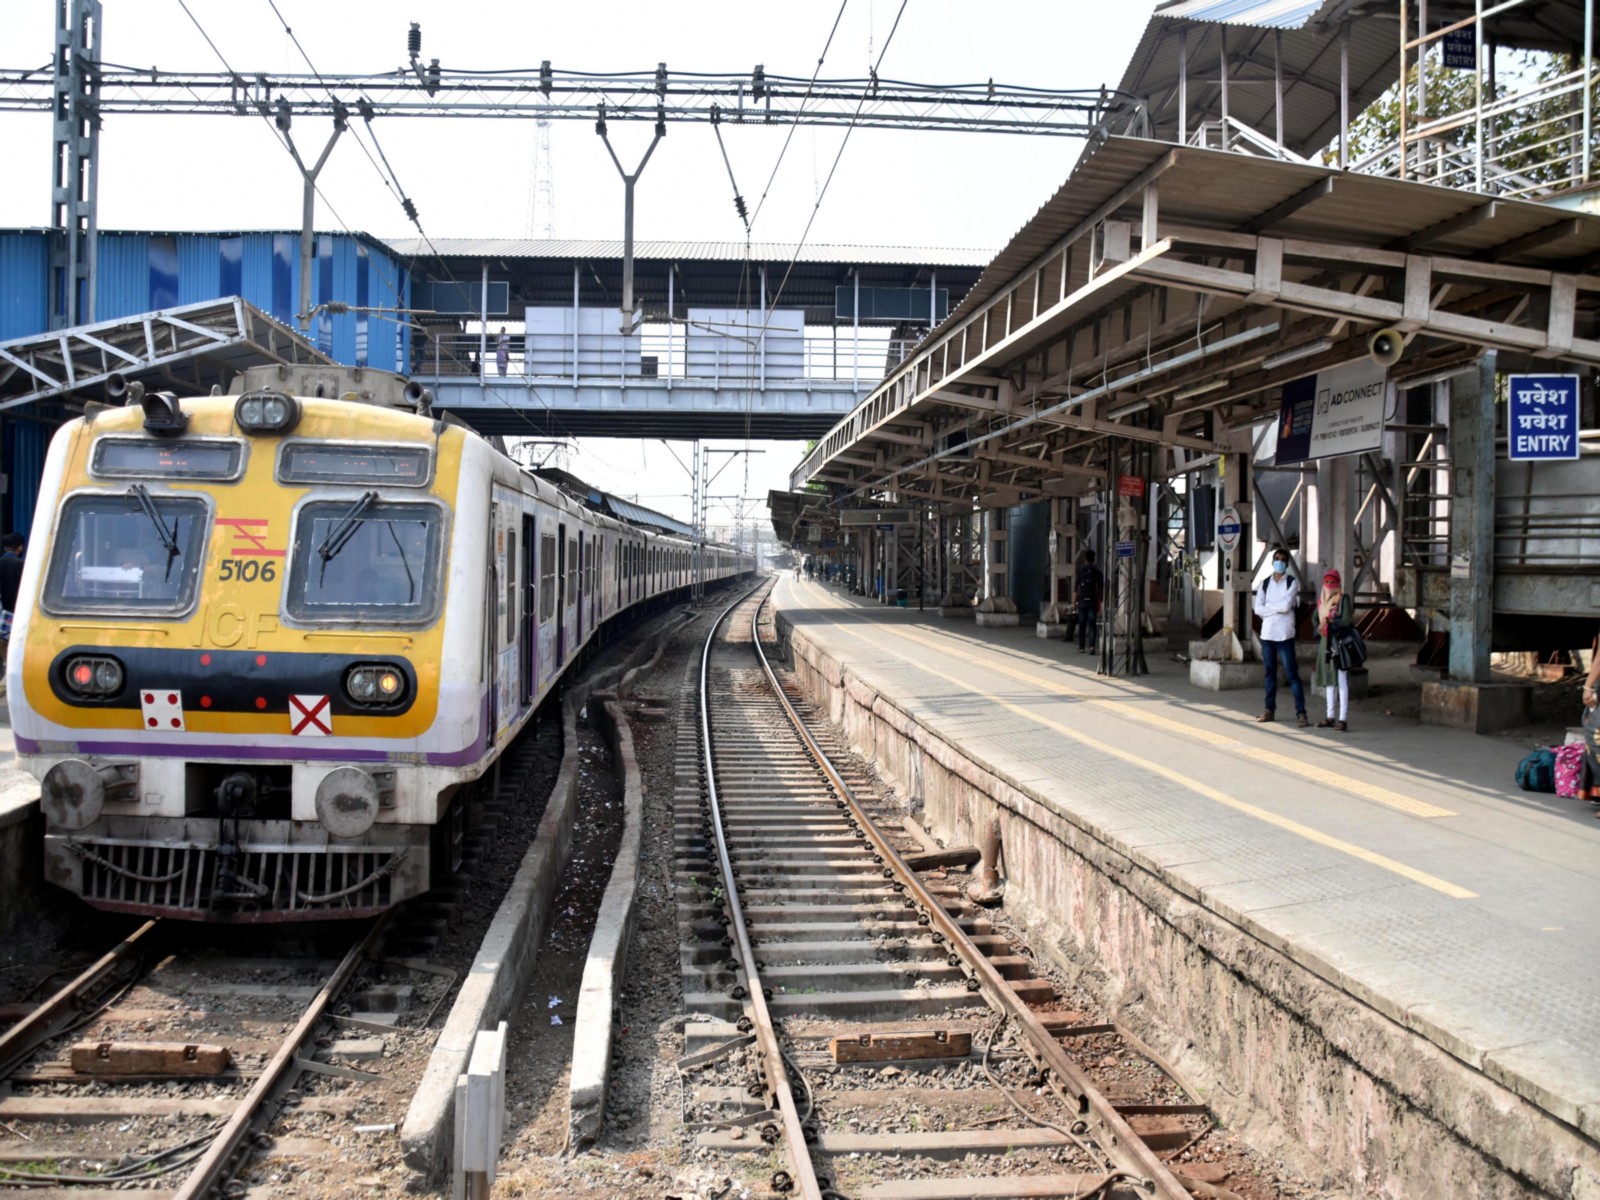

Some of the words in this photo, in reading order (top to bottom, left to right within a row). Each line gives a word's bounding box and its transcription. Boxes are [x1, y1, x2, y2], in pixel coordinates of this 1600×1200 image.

[1446, 55, 1475, 66] ENTRY
[1517, 383, 1568, 405] प्रवेश
[1517, 407, 1568, 430] प्रवेश
[1517, 435, 1571, 452] ENTRY
[218, 559, 276, 582] 5106
[192, 602, 280, 650] ICF
